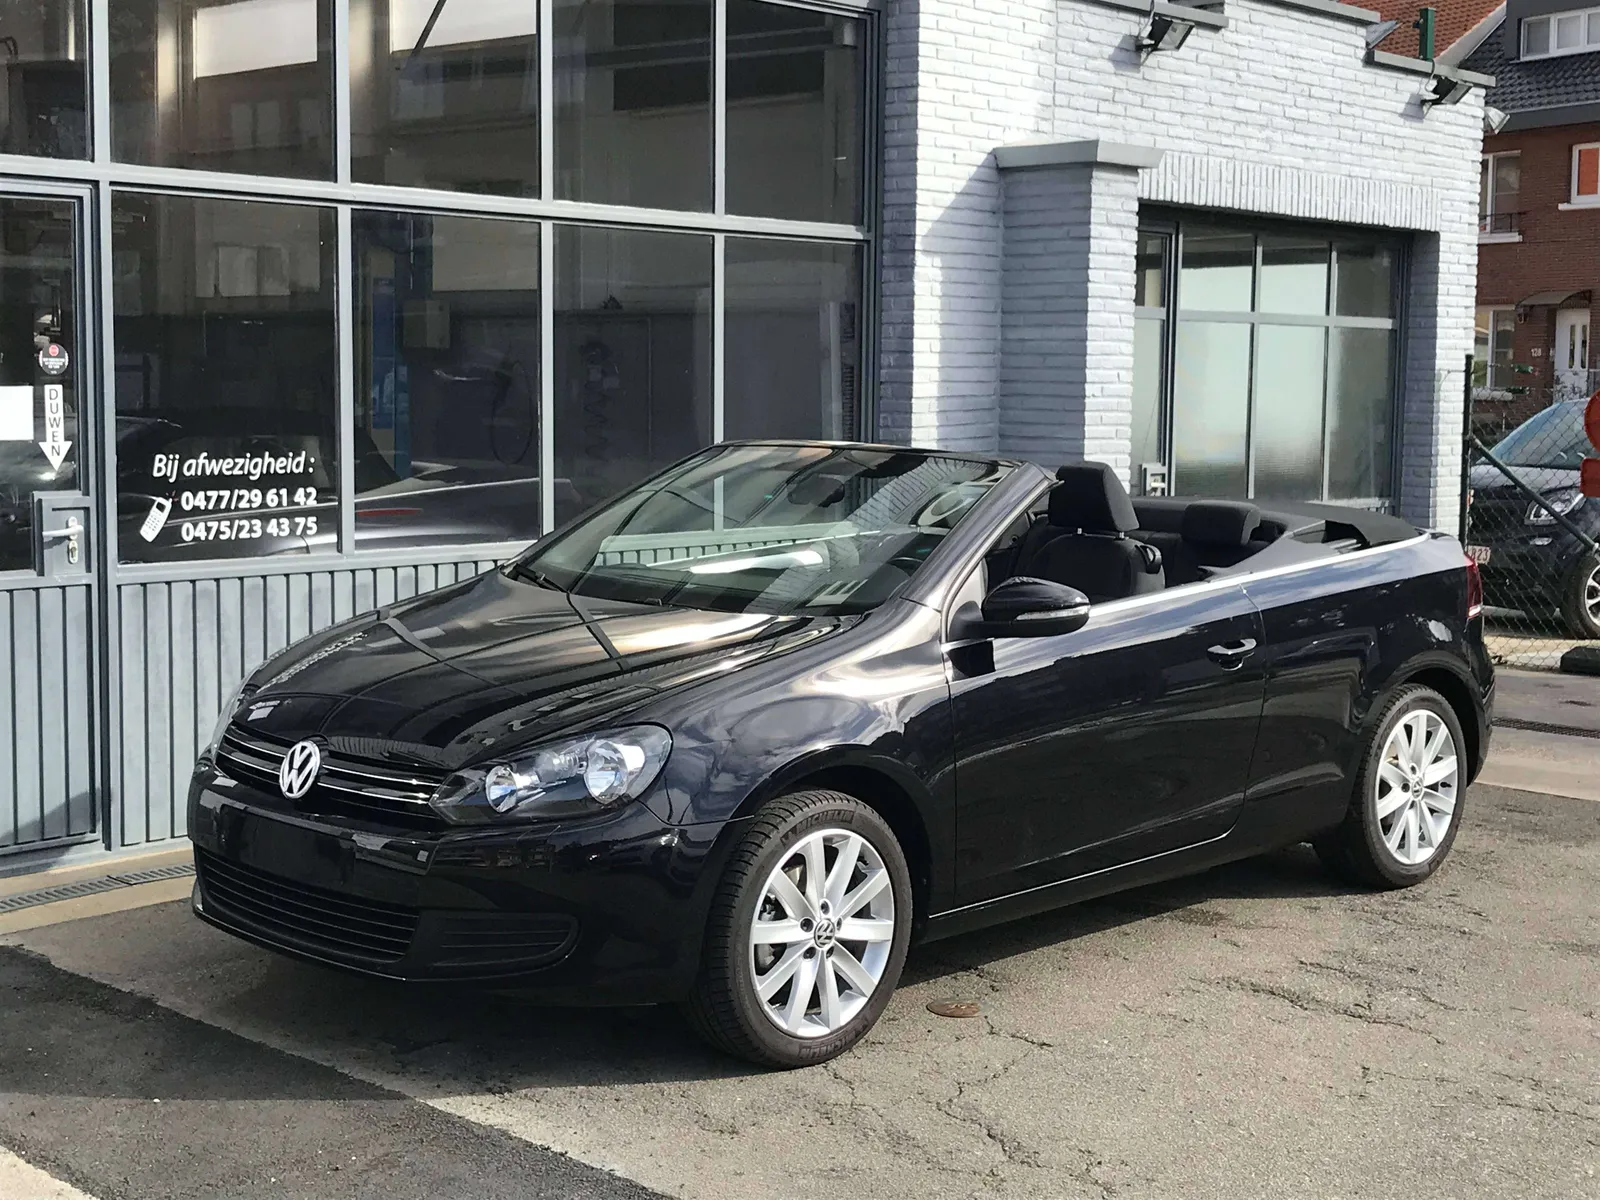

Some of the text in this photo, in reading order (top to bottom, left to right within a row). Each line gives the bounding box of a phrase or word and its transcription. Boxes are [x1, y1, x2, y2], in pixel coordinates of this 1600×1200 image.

[49, 388, 61, 457] DUWEN
[152, 453, 180, 483] Bij
[182, 450, 306, 481] afwezigheid
[180, 486, 318, 512] 0477/29 61 42
[181, 516, 318, 542] 0475/23 43 75
